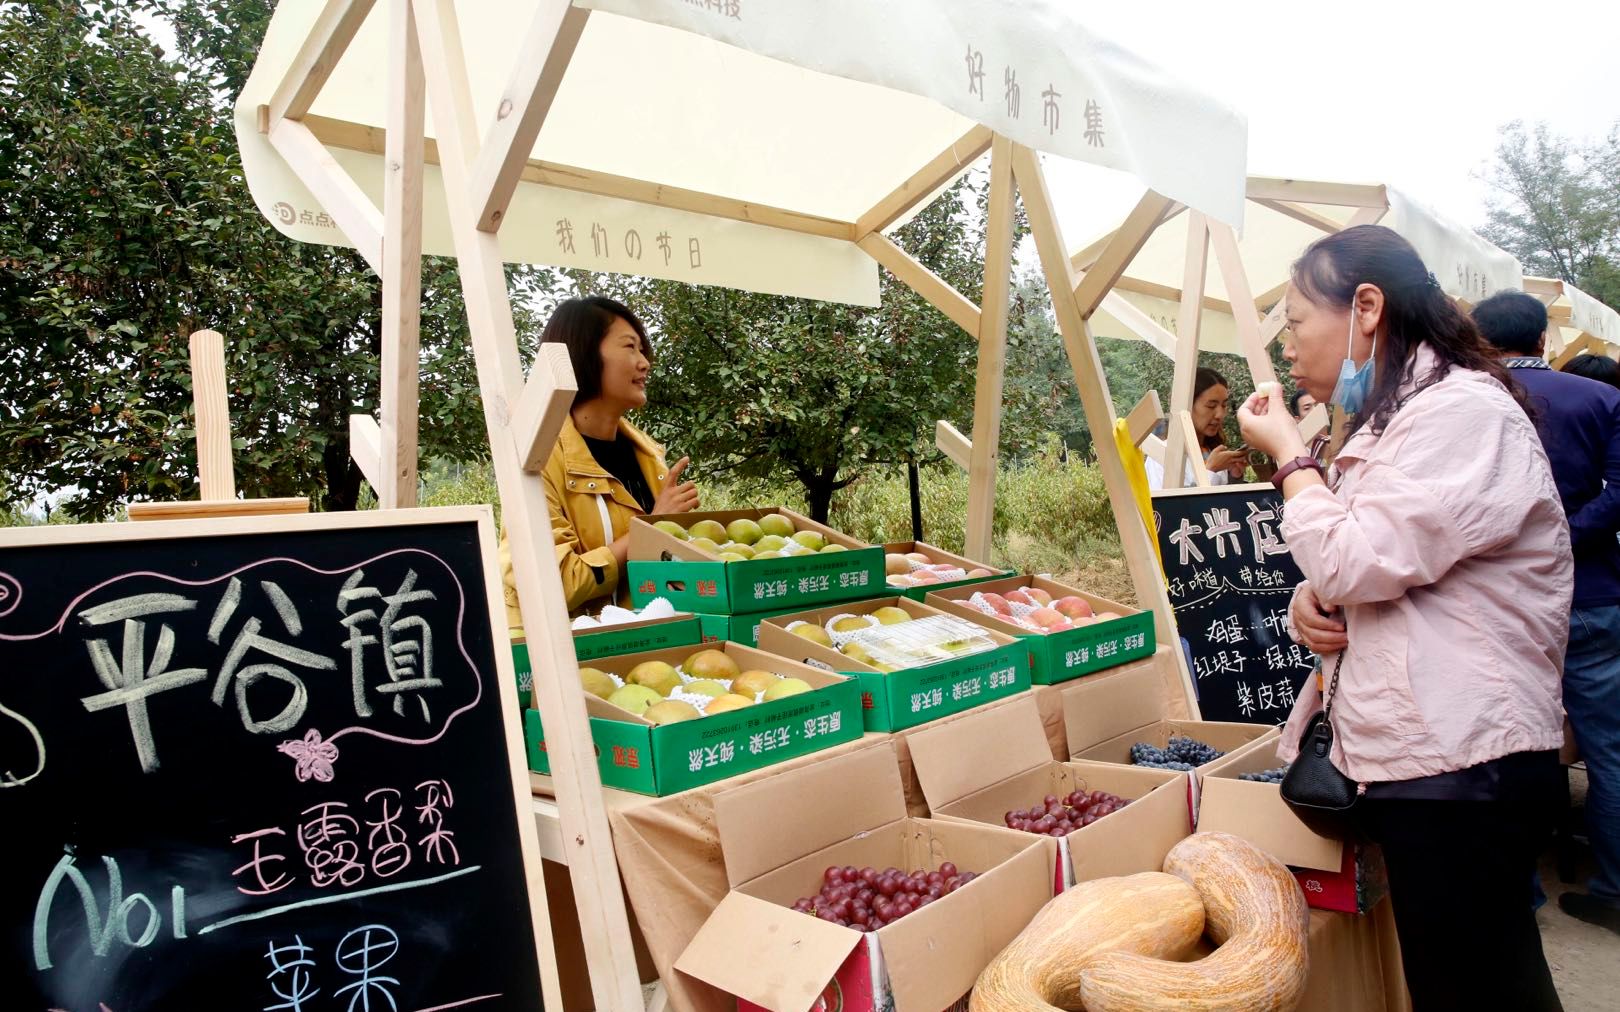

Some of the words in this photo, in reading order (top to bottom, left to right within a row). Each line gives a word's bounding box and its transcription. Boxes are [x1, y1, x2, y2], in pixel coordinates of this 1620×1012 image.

[964, 44, 1105, 147] 好物市集
[556, 217, 702, 270] 我们の节日
[1167, 566, 1219, 597] 好味道
[1238, 565, 1286, 587] 带给你
[79, 568, 443, 773] 平谷镇
[1236, 676, 1295, 718] 紫皮蒜
[231, 779, 460, 895] 玉露香梨
[263, 924, 400, 1012] 苹果
